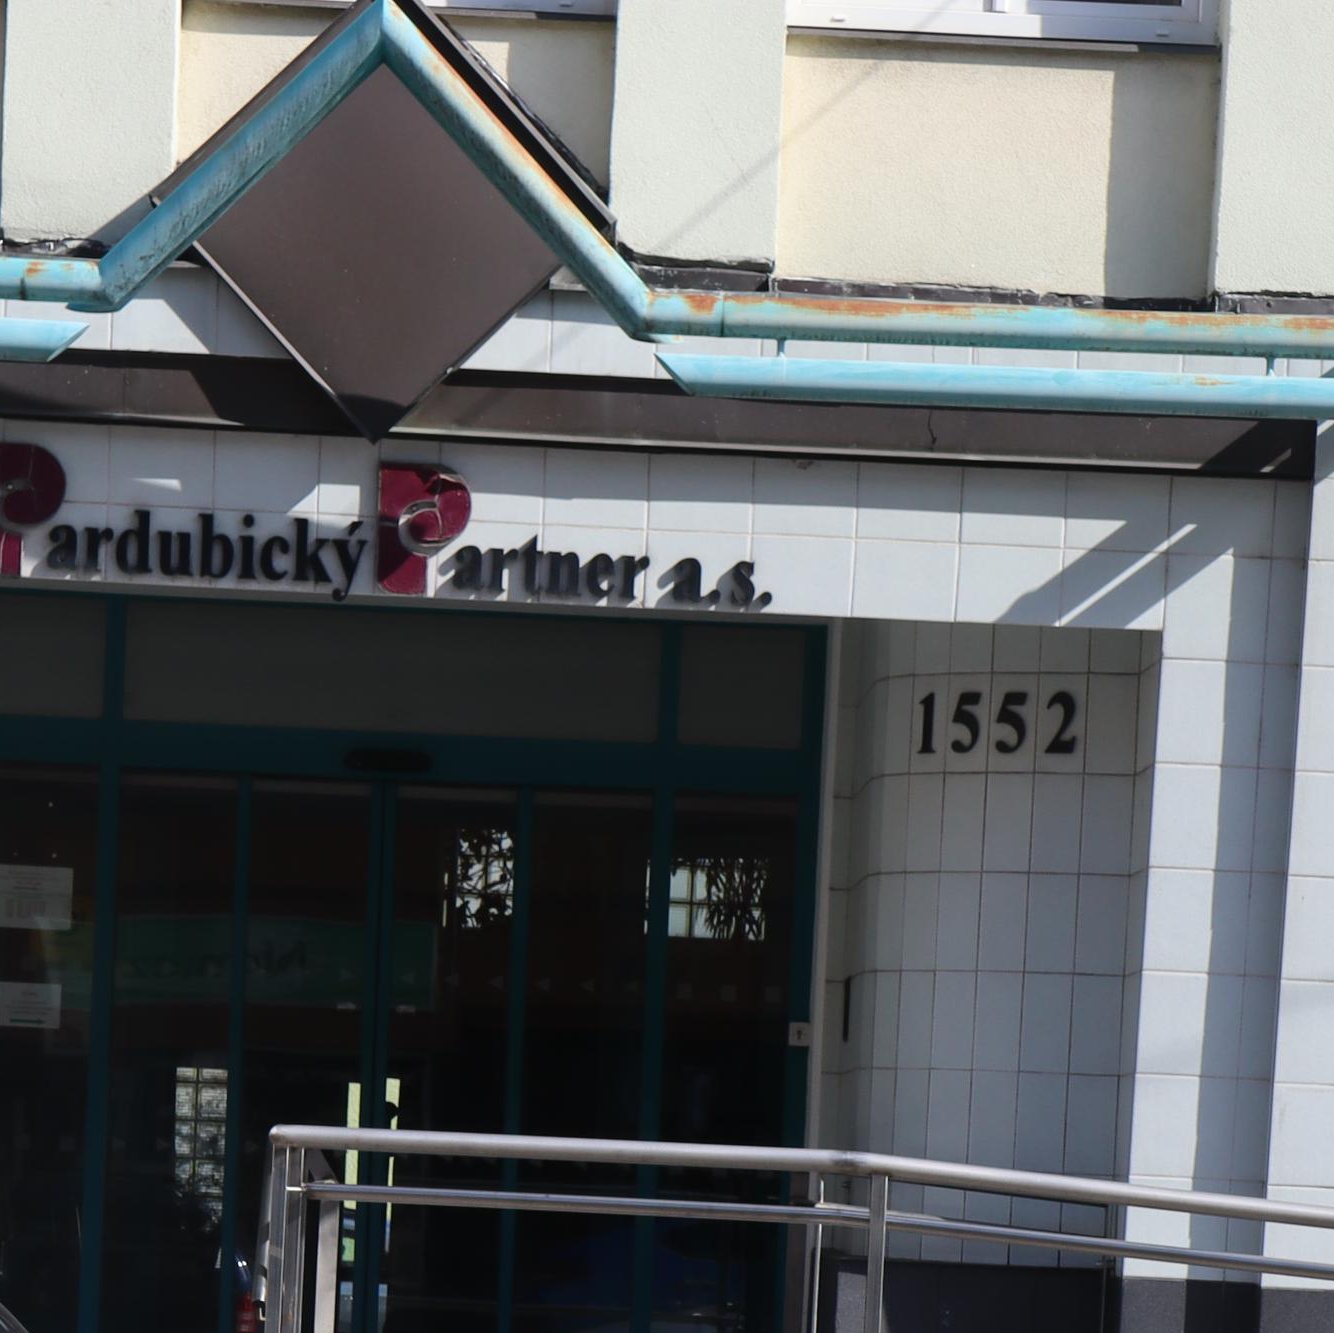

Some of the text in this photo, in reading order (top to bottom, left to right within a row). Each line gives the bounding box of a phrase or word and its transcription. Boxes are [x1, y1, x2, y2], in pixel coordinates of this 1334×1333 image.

[376, 461, 651, 599] Partner
[671, 556, 772, 611] a.s.
[917, 690, 1078, 754] 1552
